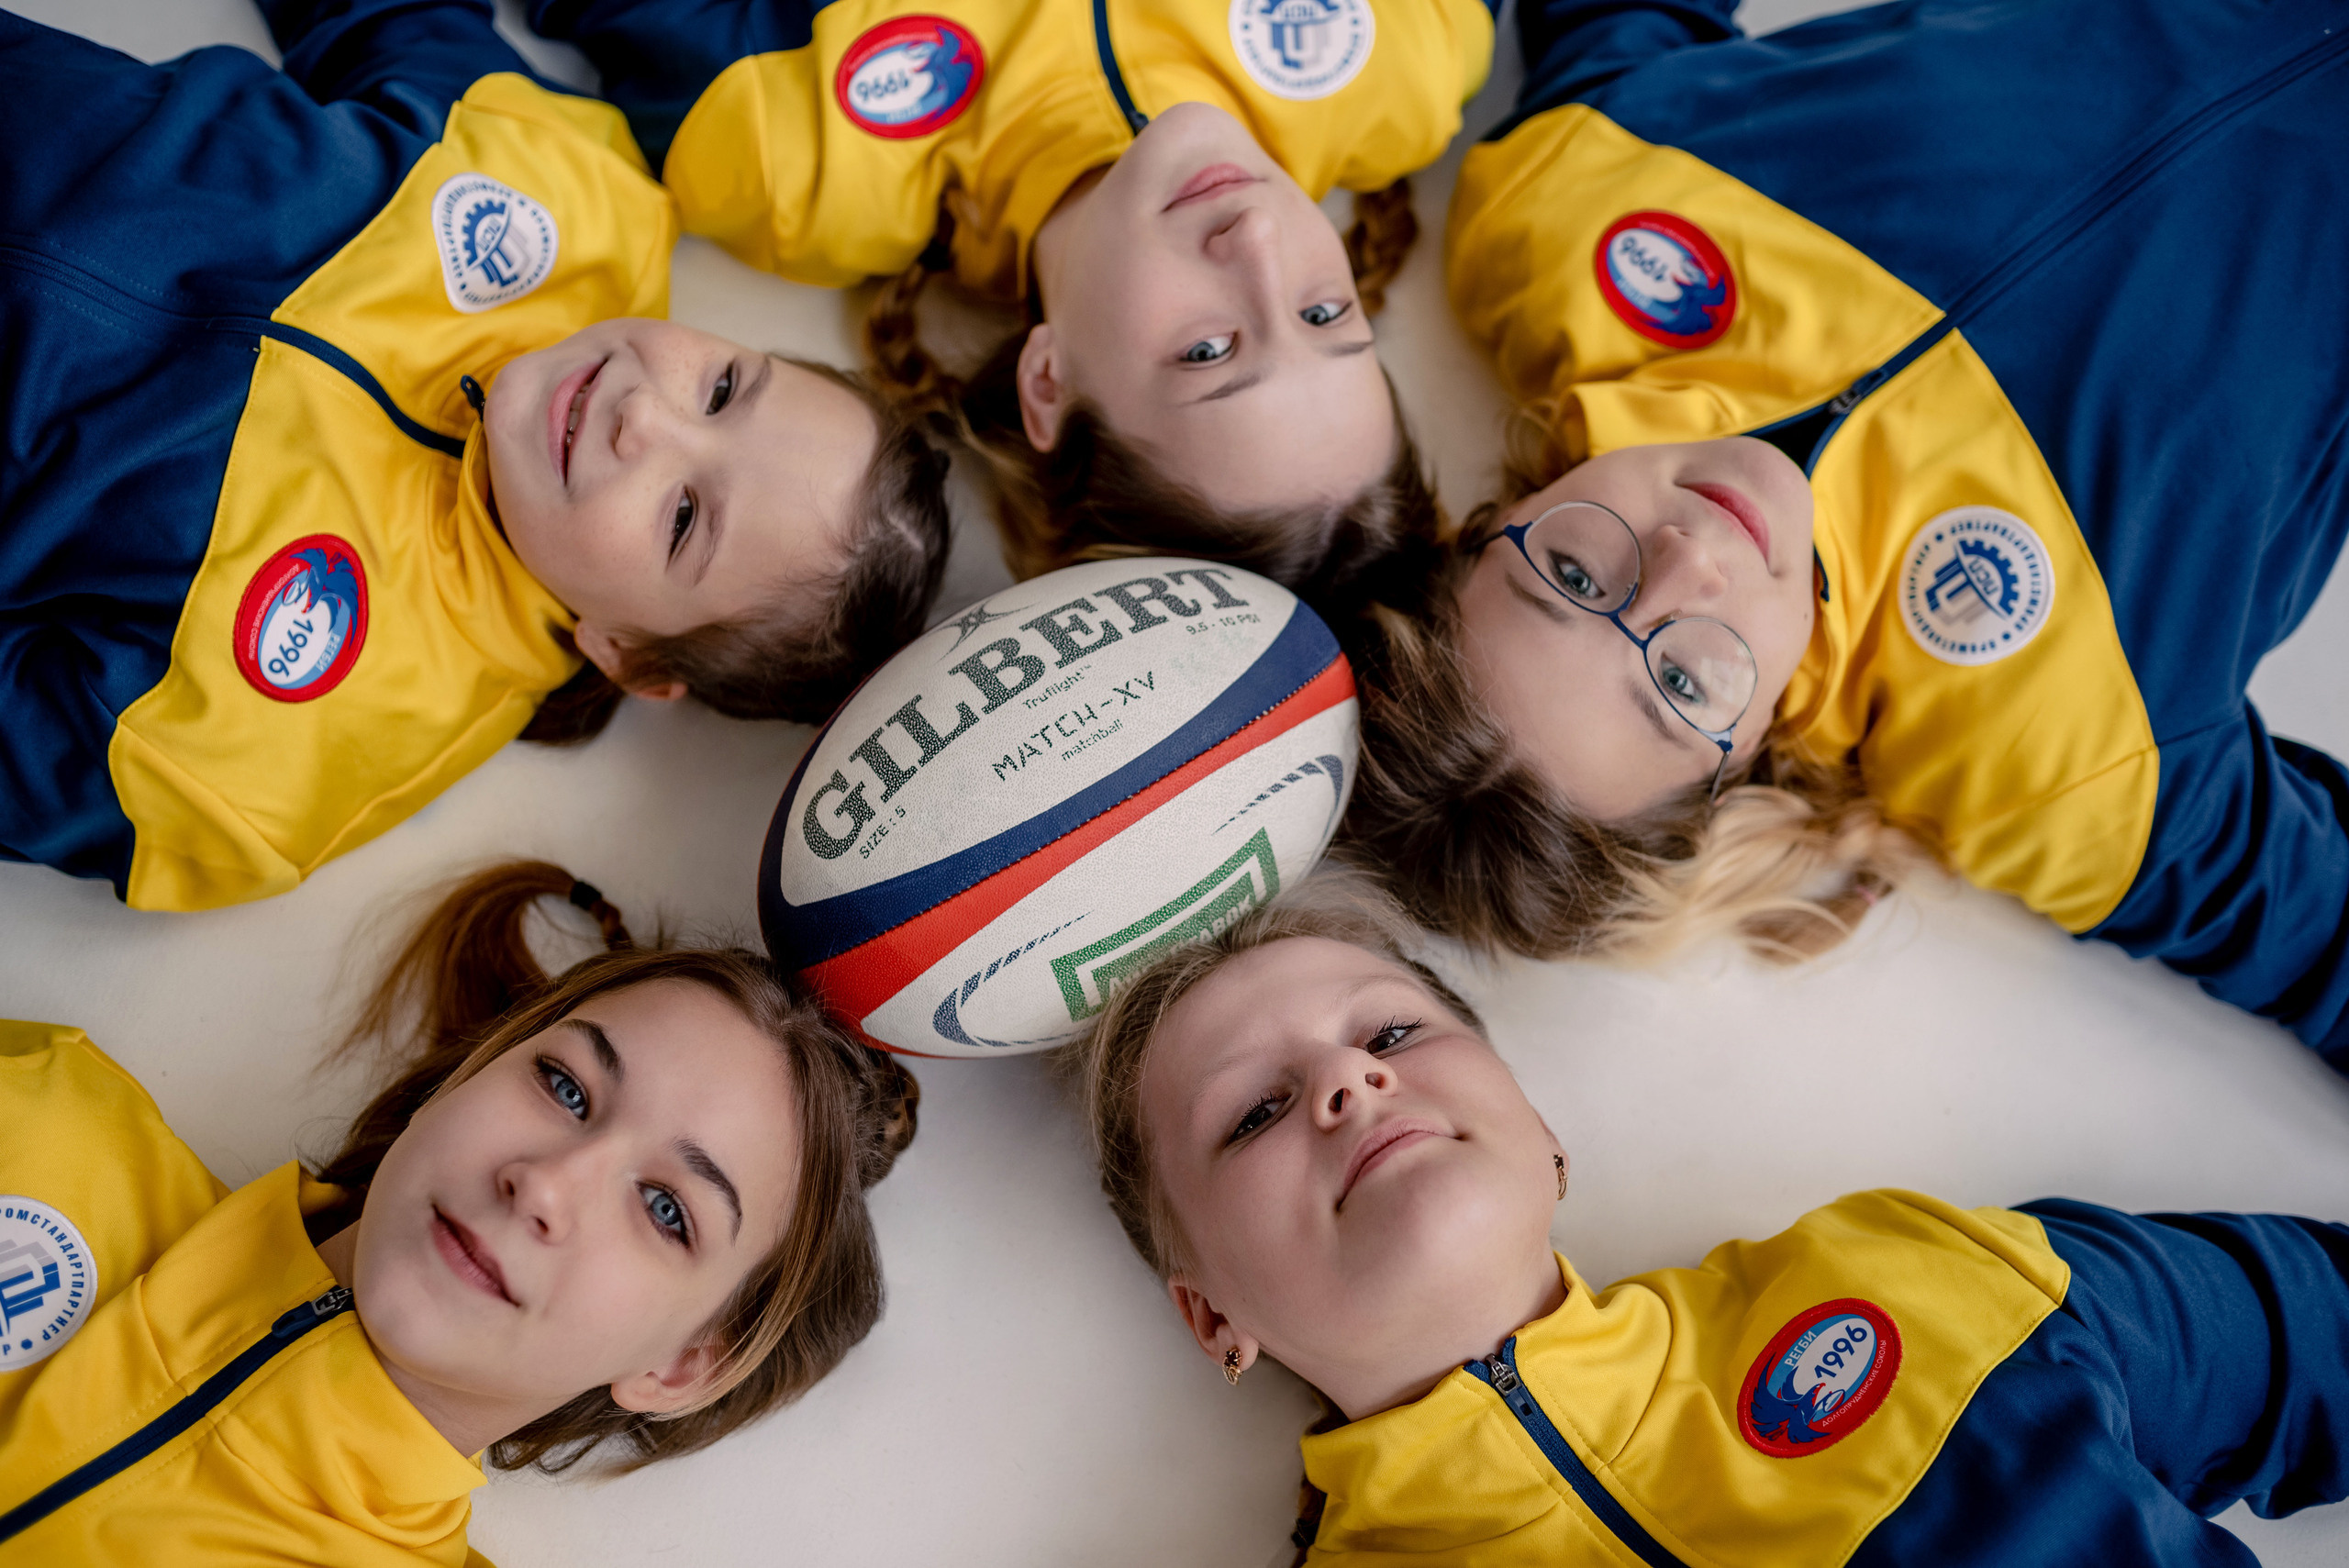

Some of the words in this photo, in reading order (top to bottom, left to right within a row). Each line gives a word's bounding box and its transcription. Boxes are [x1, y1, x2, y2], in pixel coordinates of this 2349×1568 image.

[856, 71, 909, 103] 1996
[1620, 237, 1667, 283] 1996
[268, 619, 314, 678] 1996
[803, 567, 1250, 861] GILBERT
[1062, 718, 1124, 762] matchball
[0, 1207, 84, 1341] ОМСТАНДАРТПАРТНЕР
[1785, 1329, 1817, 1367] РЕГБИ
[1814, 1324, 1868, 1379] 1996
[1822, 1367, 1879, 1428] ДОЛГОПРУДНЕНСКИЕ
[1876, 1340, 1887, 1369] СОКОЛЫ
